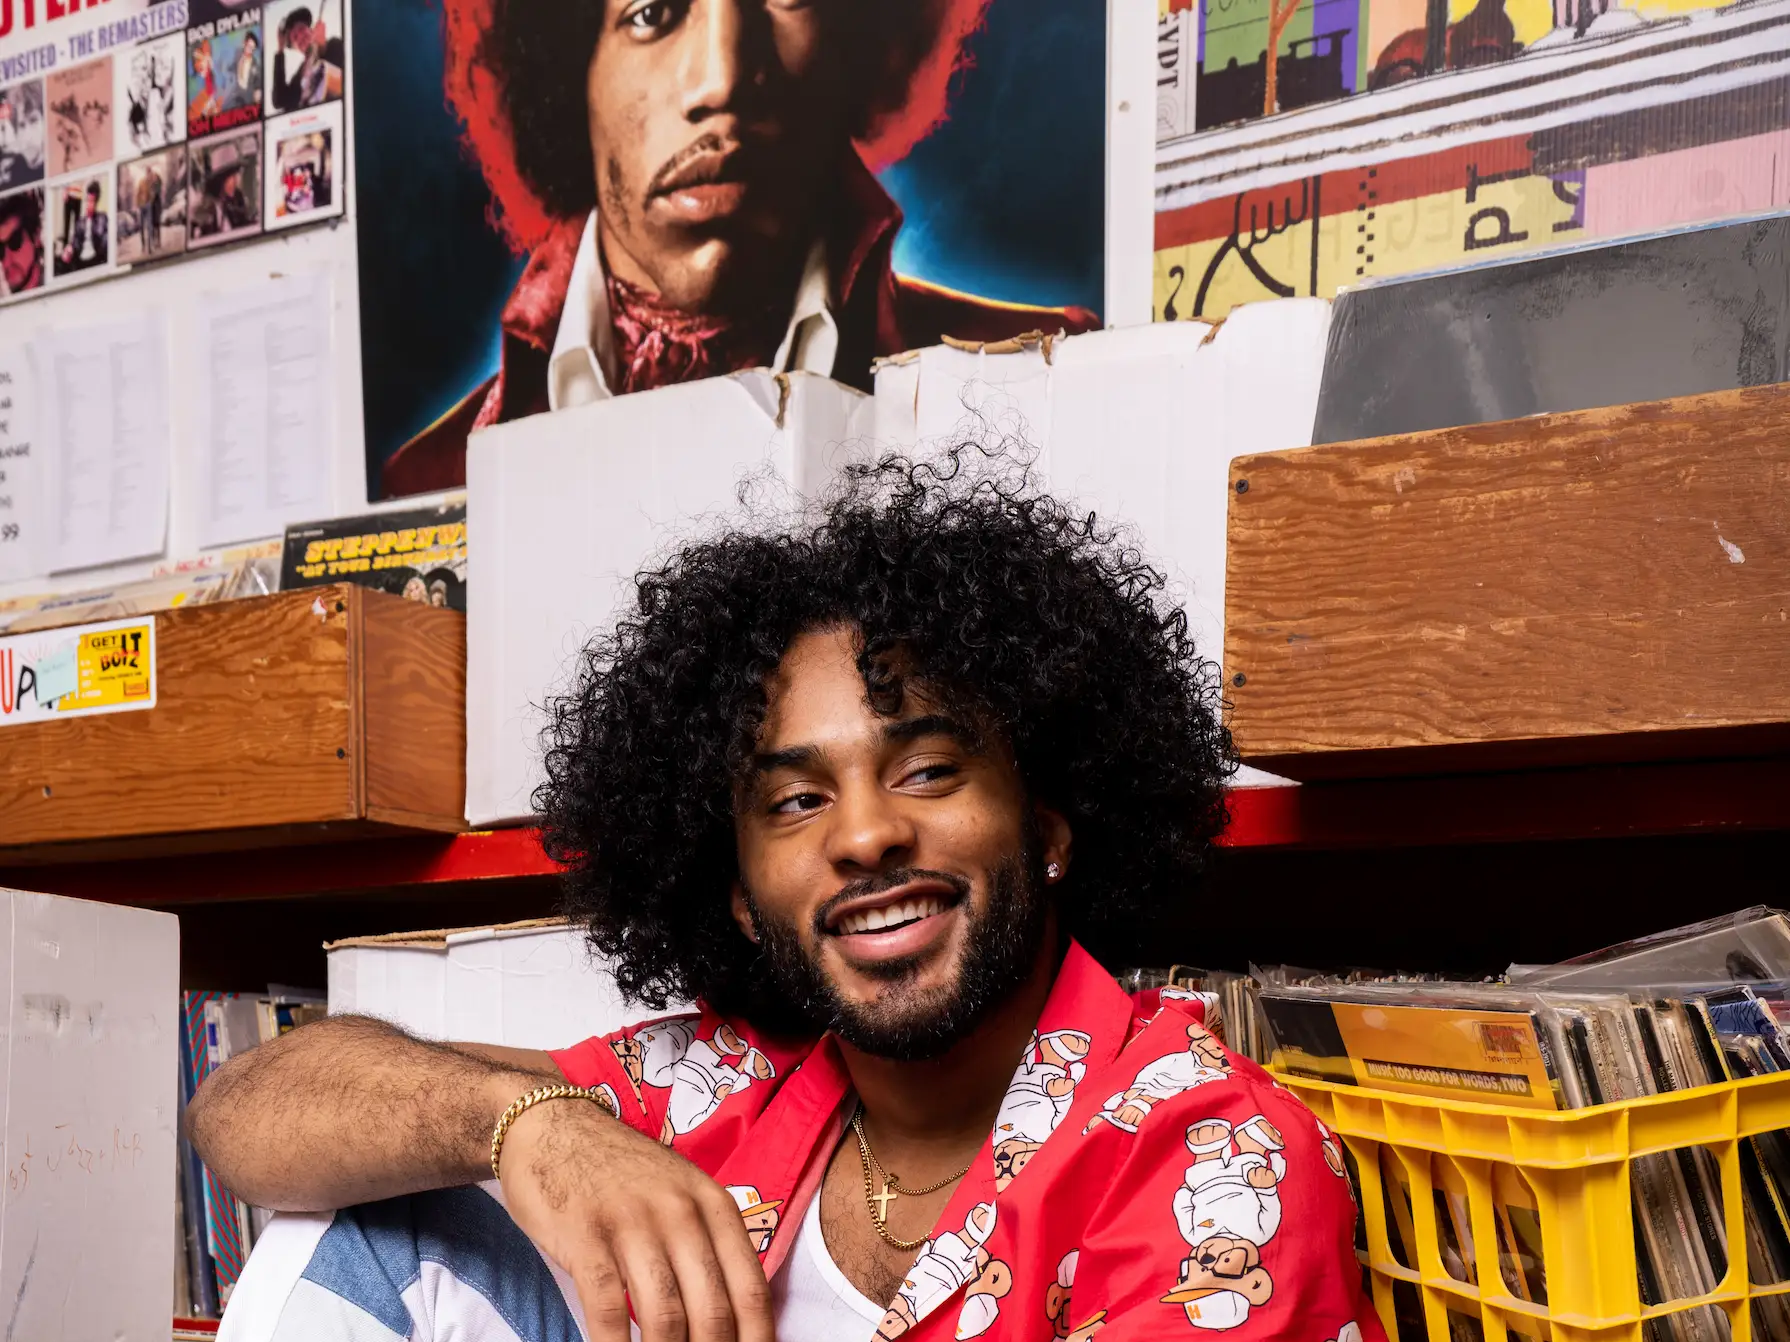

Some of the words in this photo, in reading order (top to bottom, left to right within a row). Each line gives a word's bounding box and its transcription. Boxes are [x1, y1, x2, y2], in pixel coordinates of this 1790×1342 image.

[69, 31, 94, 60] THE
[99, 2, 187, 49] REMASTERS
[187, 22, 215, 43] BOB
[216, 8, 261, 34] DYLAN
[91, 634, 118, 648] GET
[121, 632, 142, 656] IT
[1368, 1062, 1394, 1079] MUSIC
[1393, 1065, 1412, 1081] TOO
[1412, 1067, 1440, 1085] GOOD
[1441, 1070, 1460, 1086] FOR
[1501, 1077, 1528, 1093] TWO
[746, 1190, 759, 1204] H
[1704, 1215, 1717, 1241] STONES
[1187, 1304, 1202, 1321] H
